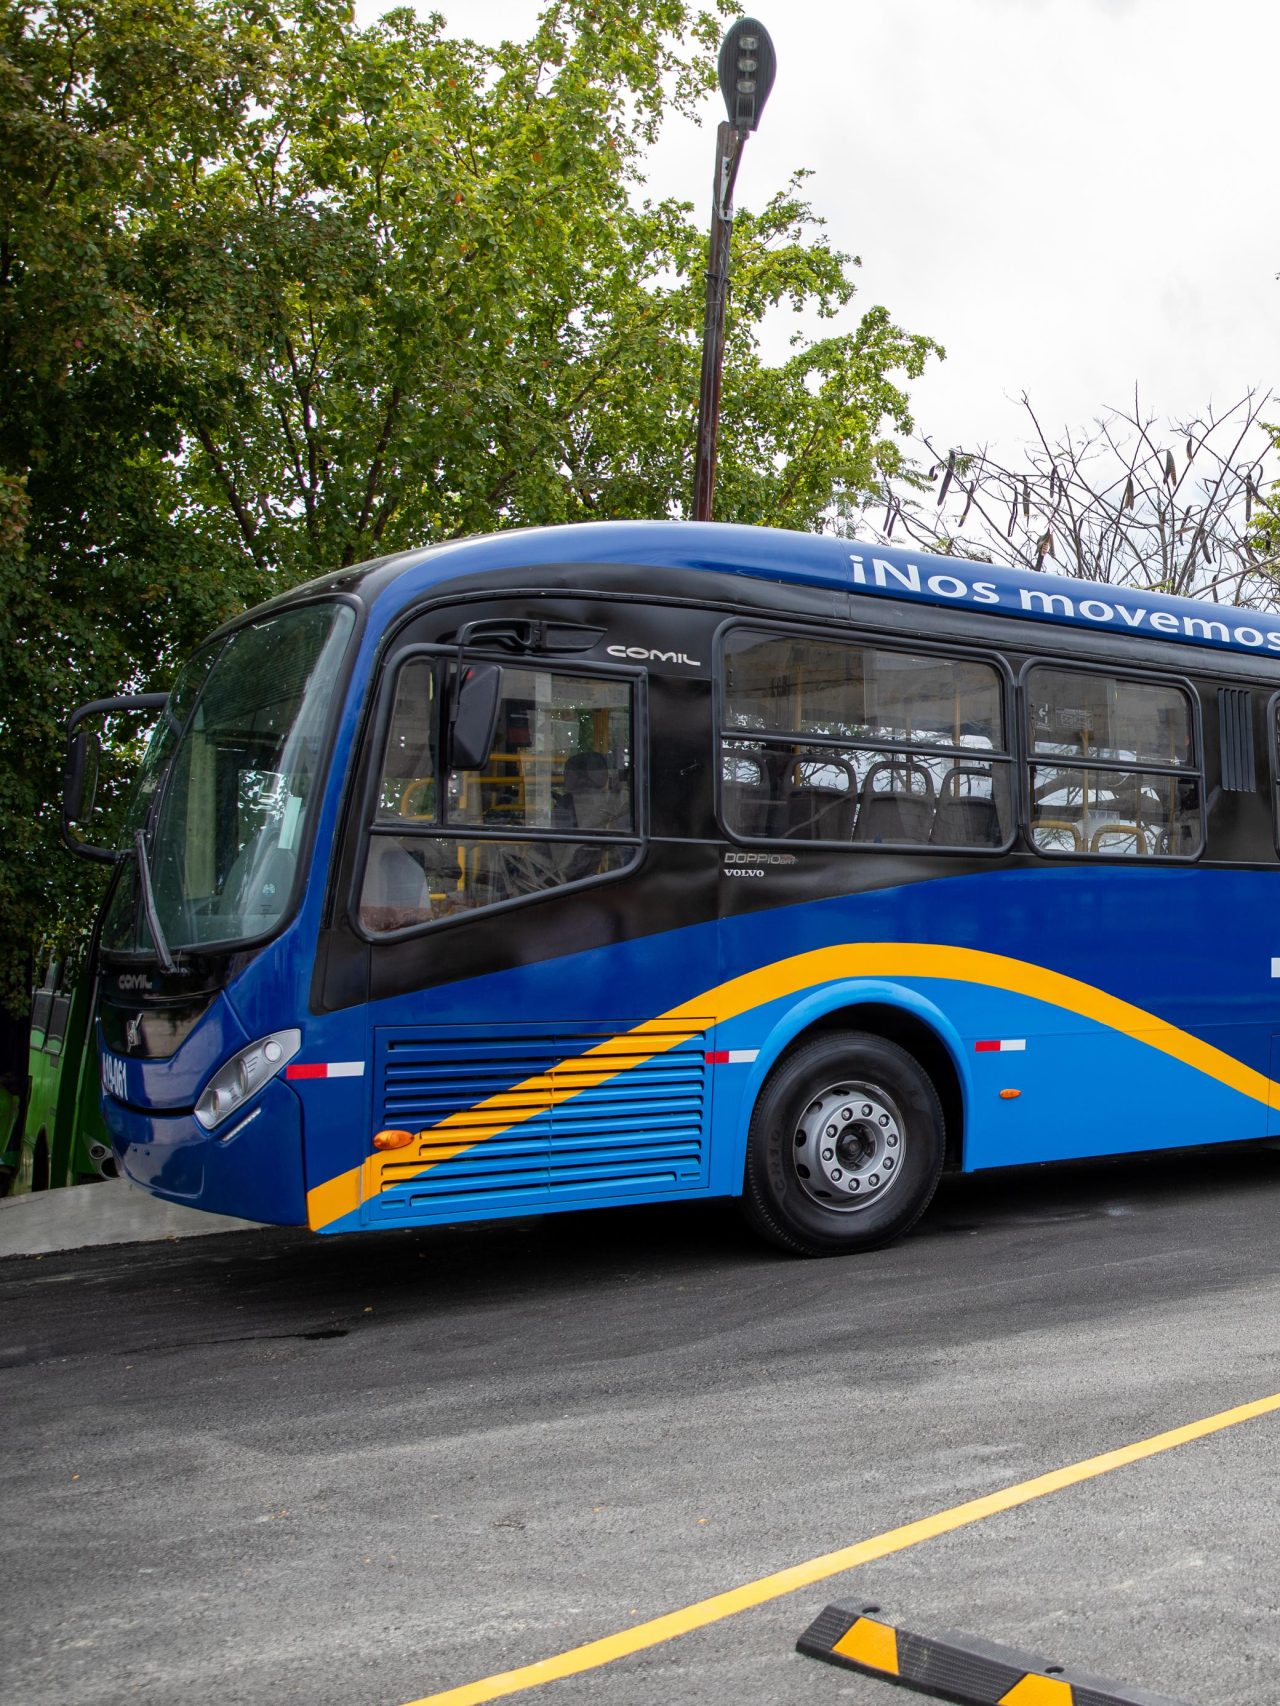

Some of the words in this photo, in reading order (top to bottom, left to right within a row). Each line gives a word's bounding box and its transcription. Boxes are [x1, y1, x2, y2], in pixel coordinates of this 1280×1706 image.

[606, 645, 701, 666] COMIL
[724, 853, 781, 864] DOPPIO
[724, 869, 765, 877] VOLVO
[118, 974, 153, 990] COMIL
